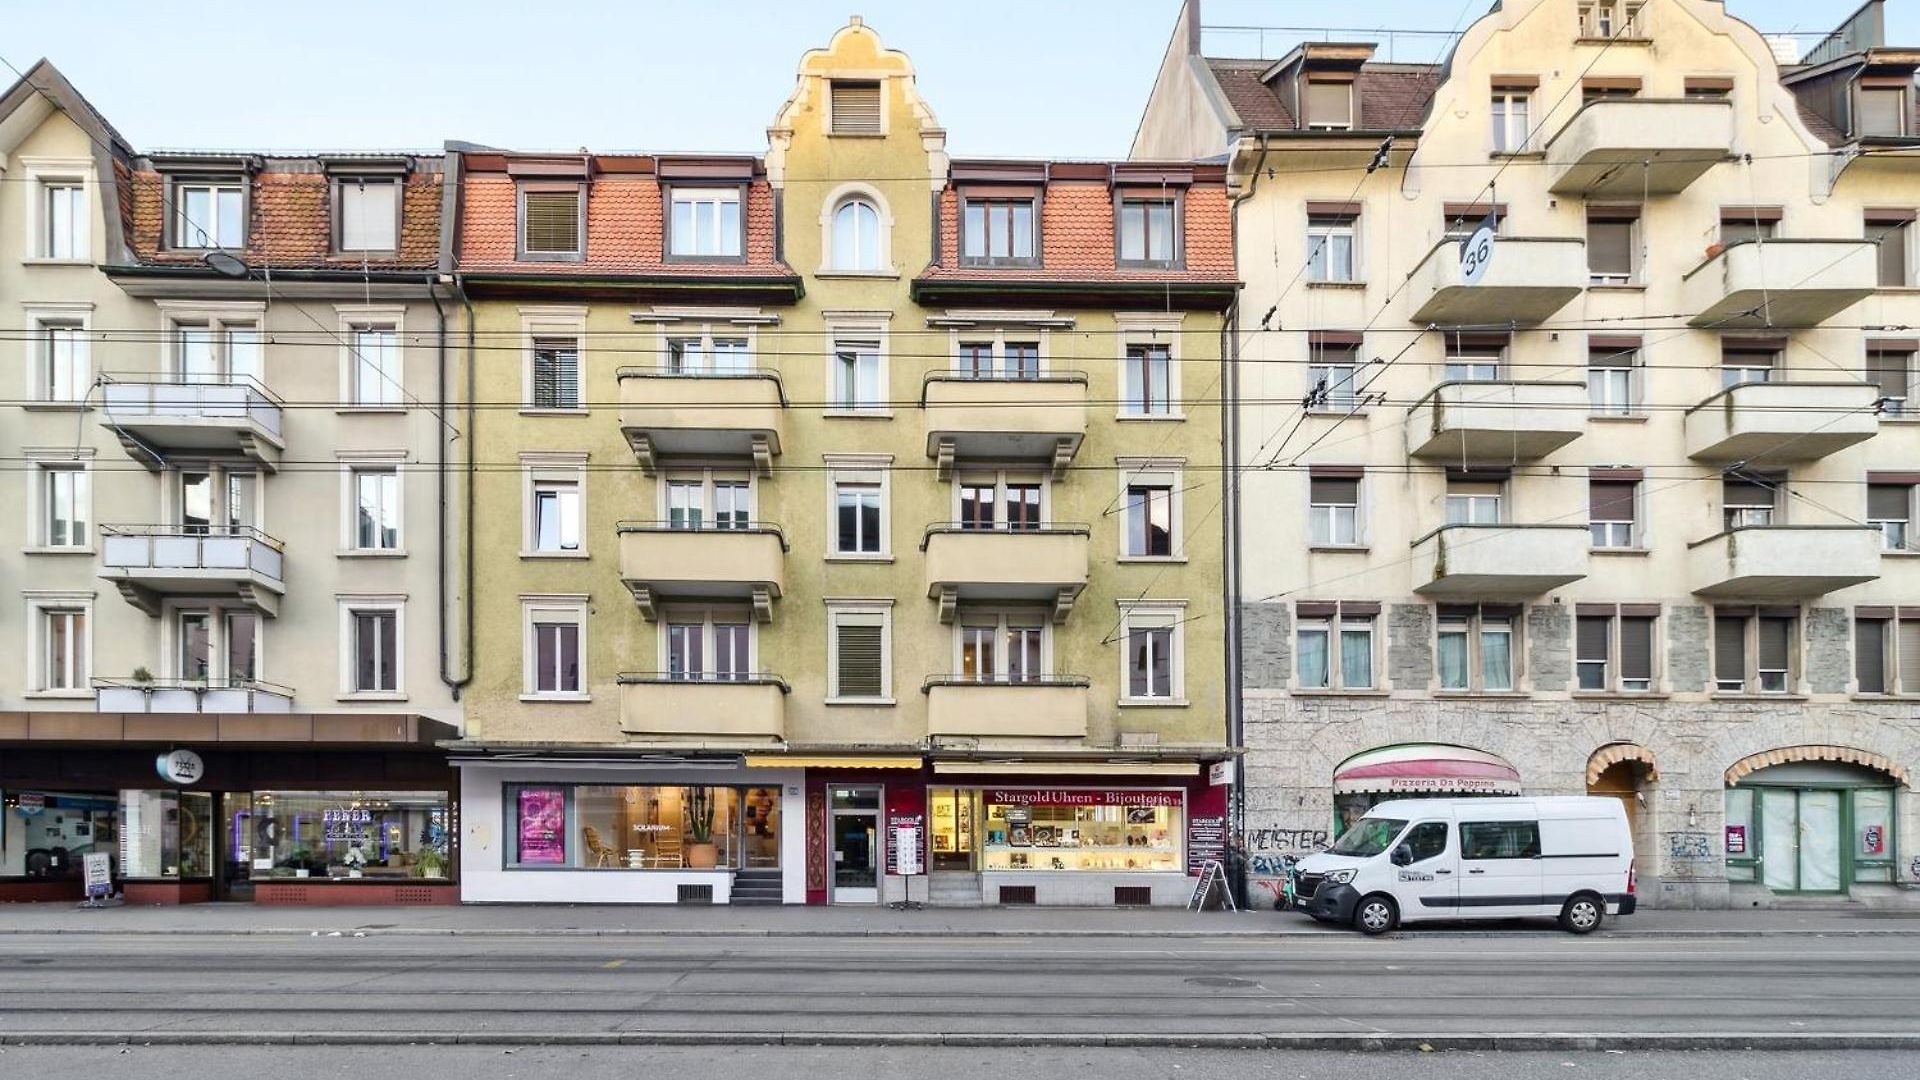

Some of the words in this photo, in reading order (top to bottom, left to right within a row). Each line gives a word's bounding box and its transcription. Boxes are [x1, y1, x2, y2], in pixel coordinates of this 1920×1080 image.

[1466, 238, 1488, 276] 36
[1391, 779, 1436, 787] Pizzeria
[1439, 779, 1454, 787] Da
[1457, 779, 1495, 788] Peppino
[995, 791, 1051, 805] Stargold
[1053, 791, 1093, 803] Uhren
[1106, 791, 1170, 805] Bijouterie
[1246, 824, 1329, 850] MEISTER
